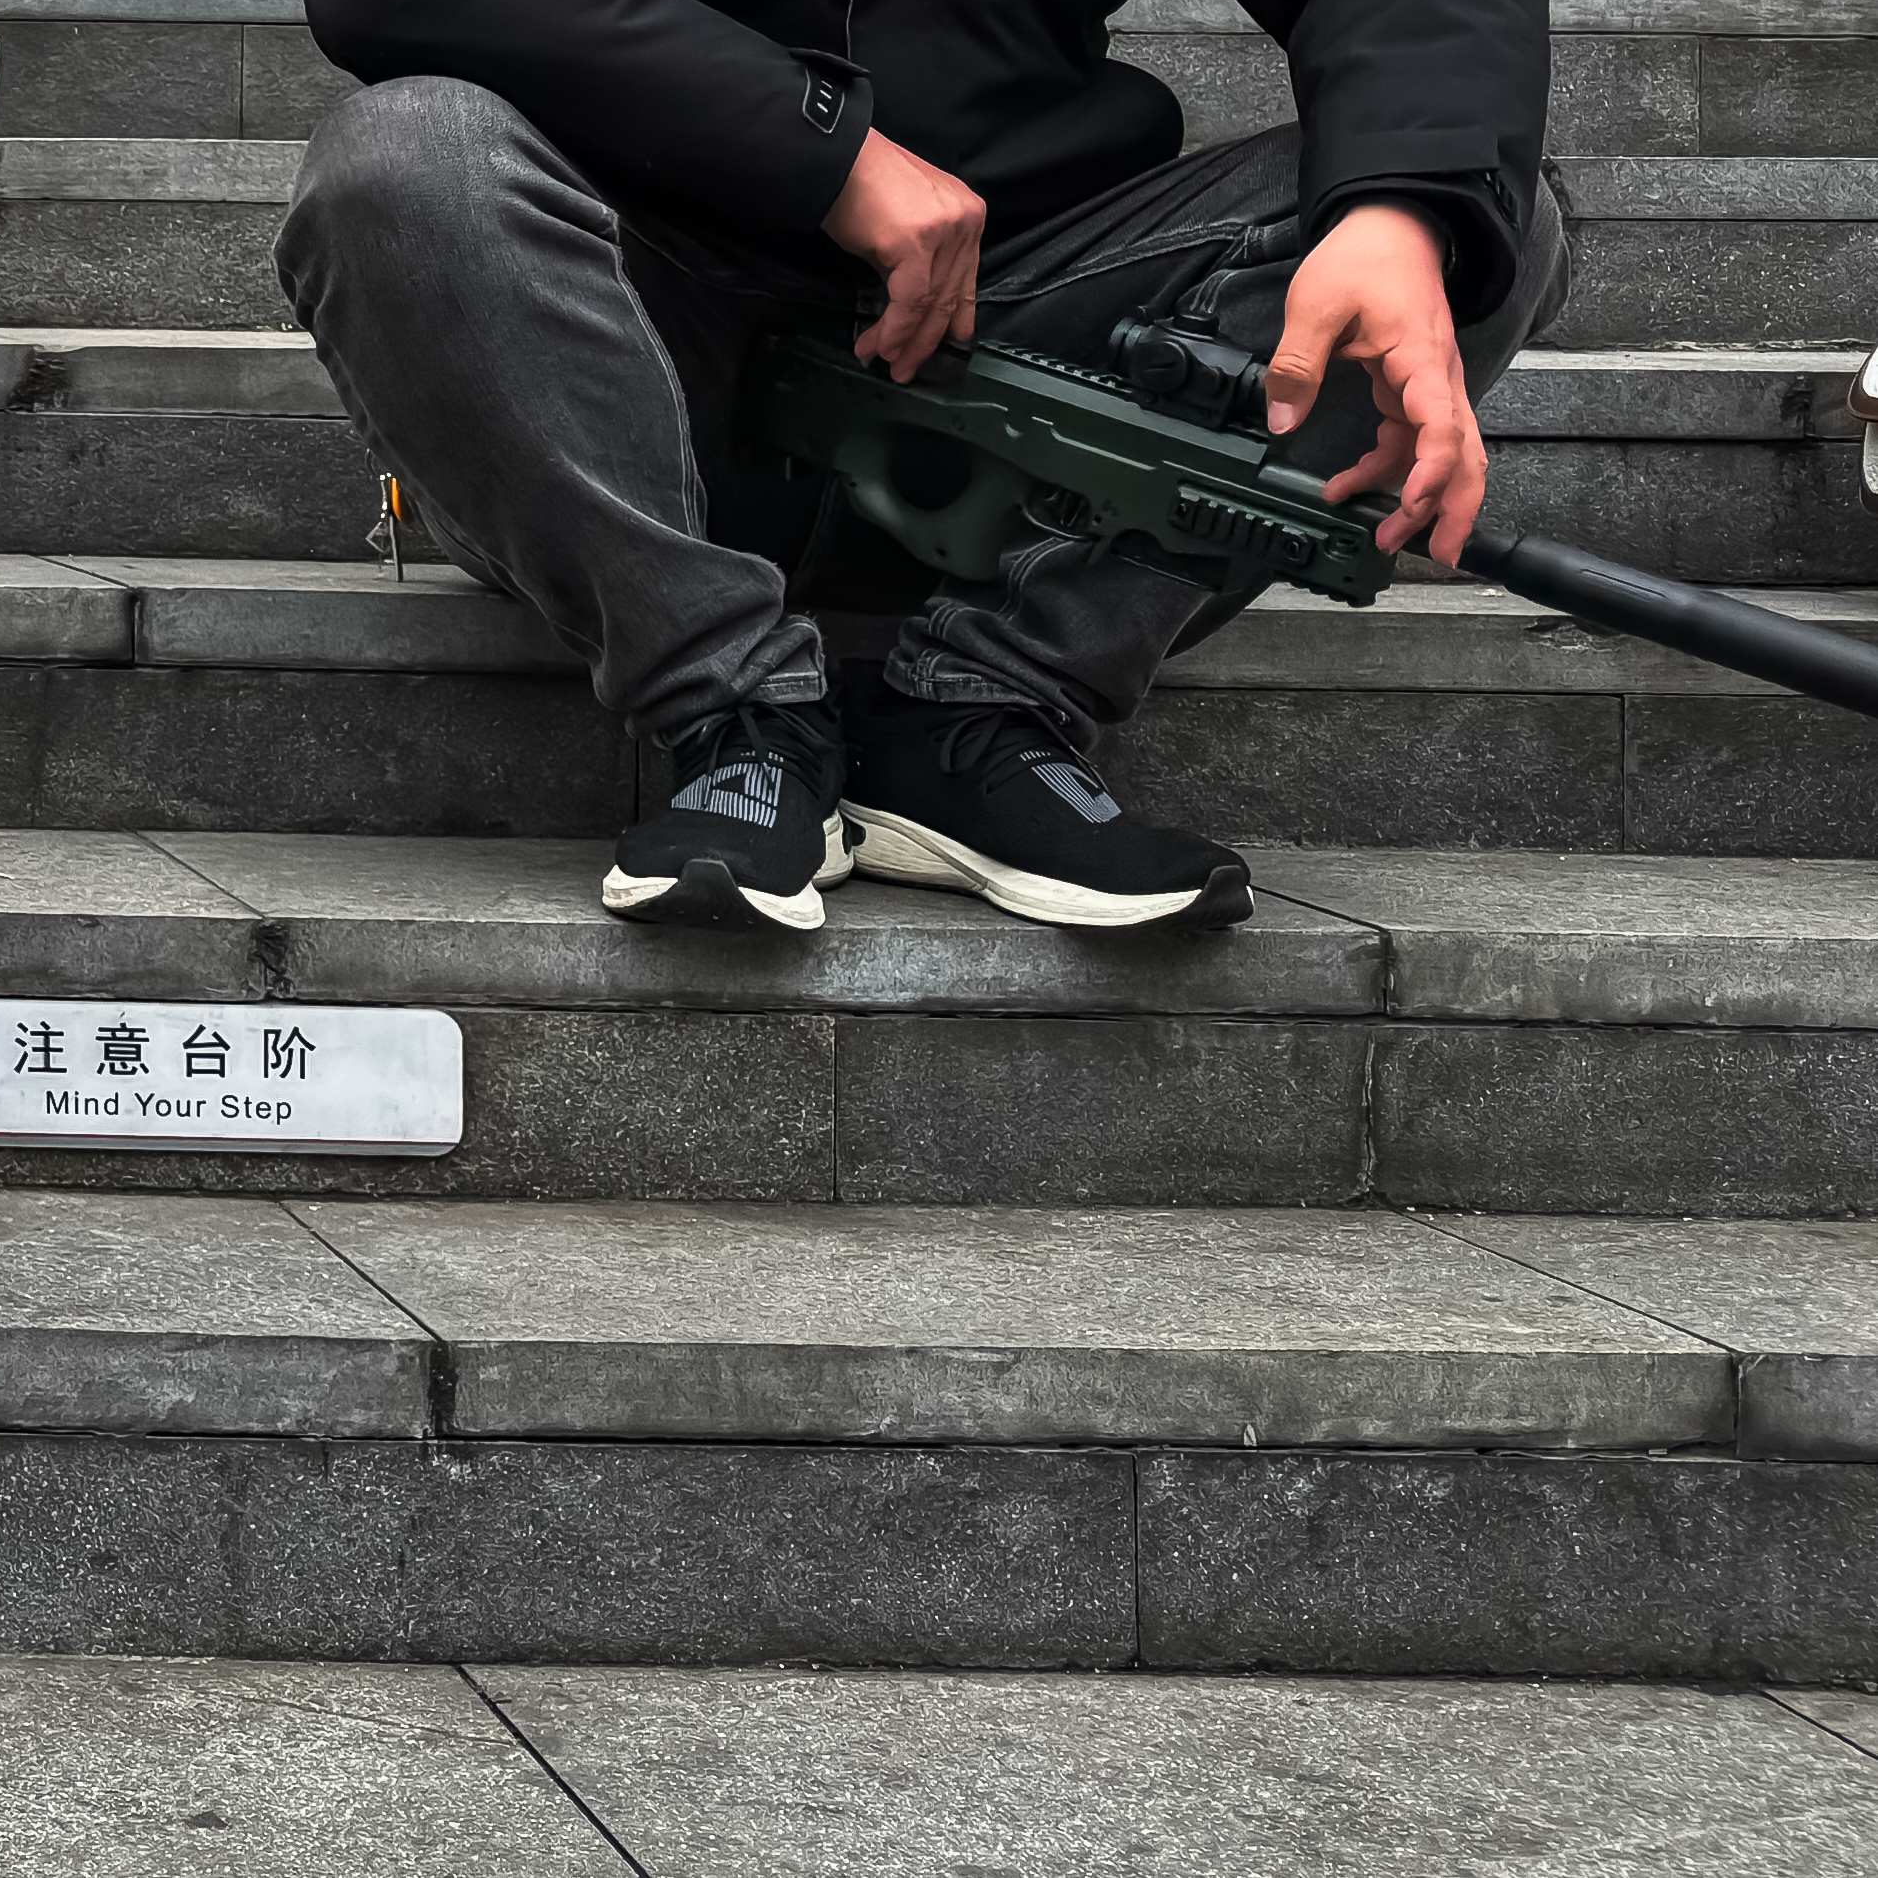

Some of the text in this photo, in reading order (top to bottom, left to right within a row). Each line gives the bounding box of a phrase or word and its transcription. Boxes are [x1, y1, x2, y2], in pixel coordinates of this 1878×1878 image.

[11, 1021, 317, 1081] 注意台阶
[44, 1089, 293, 1125] Mind Your Step
